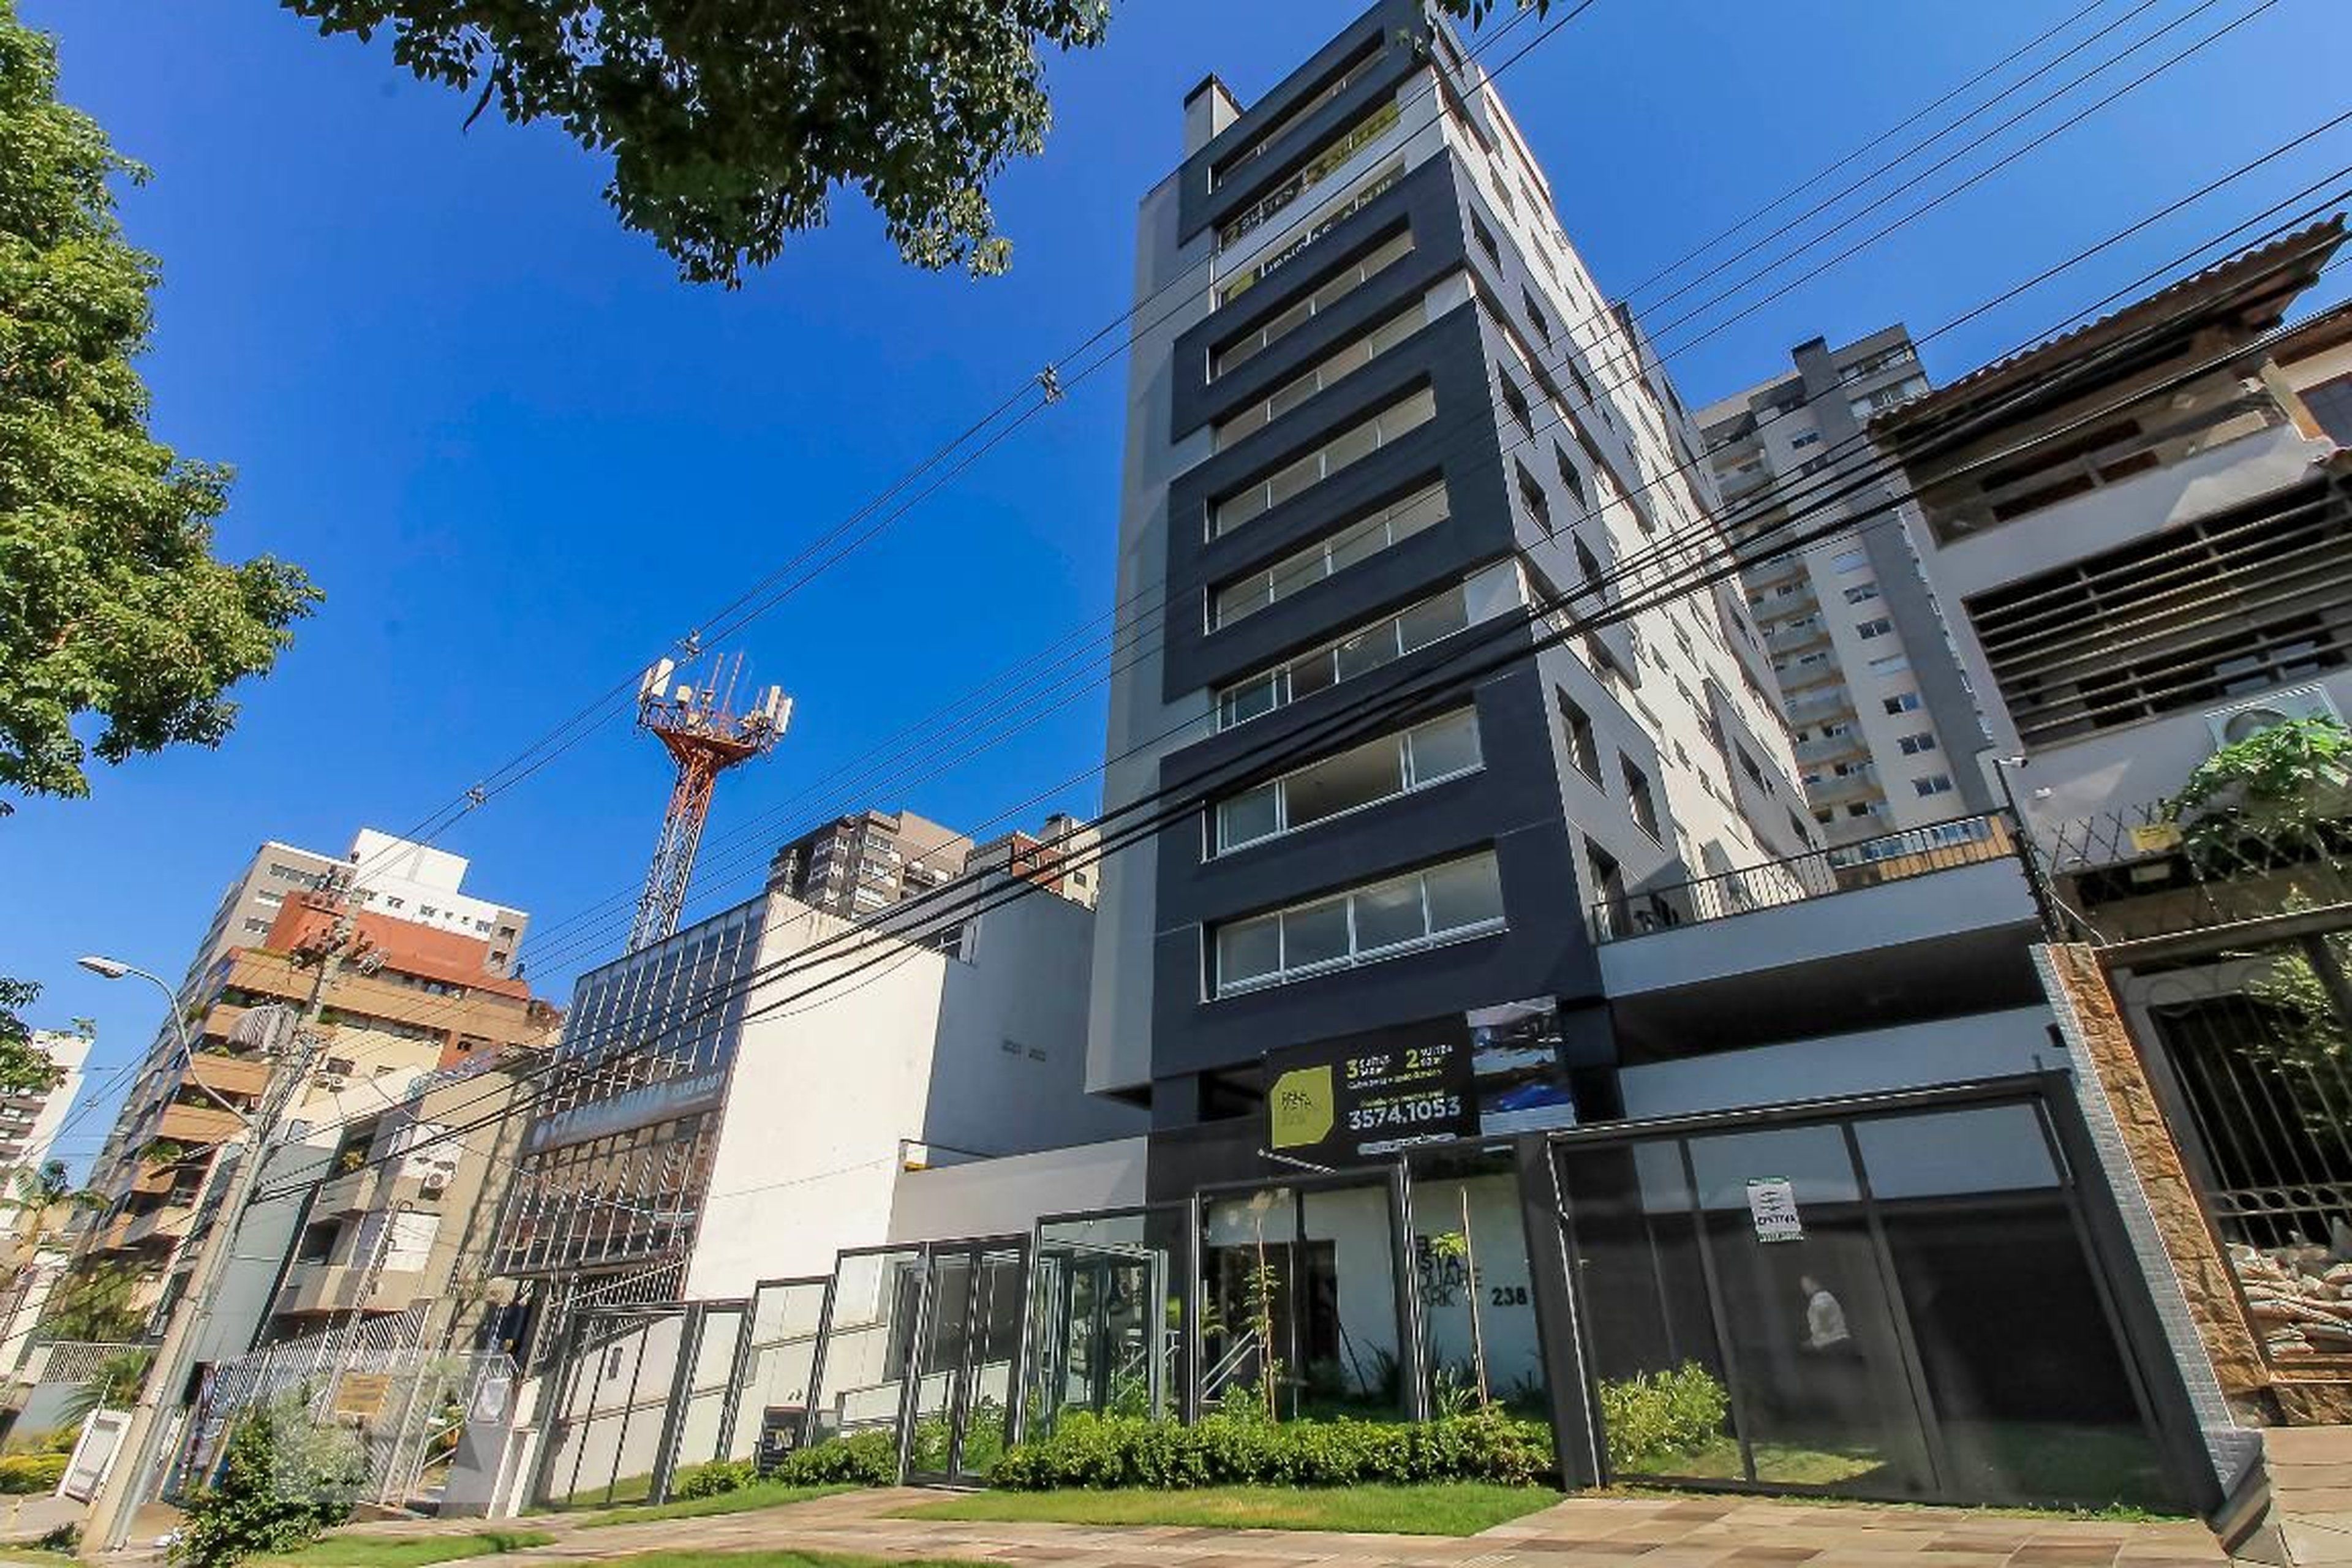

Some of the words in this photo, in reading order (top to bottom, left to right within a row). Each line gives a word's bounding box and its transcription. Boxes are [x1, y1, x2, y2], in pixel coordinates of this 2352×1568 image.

[1346, 1059, 1359, 1079] 3
[1406, 1049, 1420, 1069] 2
[1348, 1095, 1461, 1130] 3574.1053
[1491, 1287, 1528, 1306] 238
